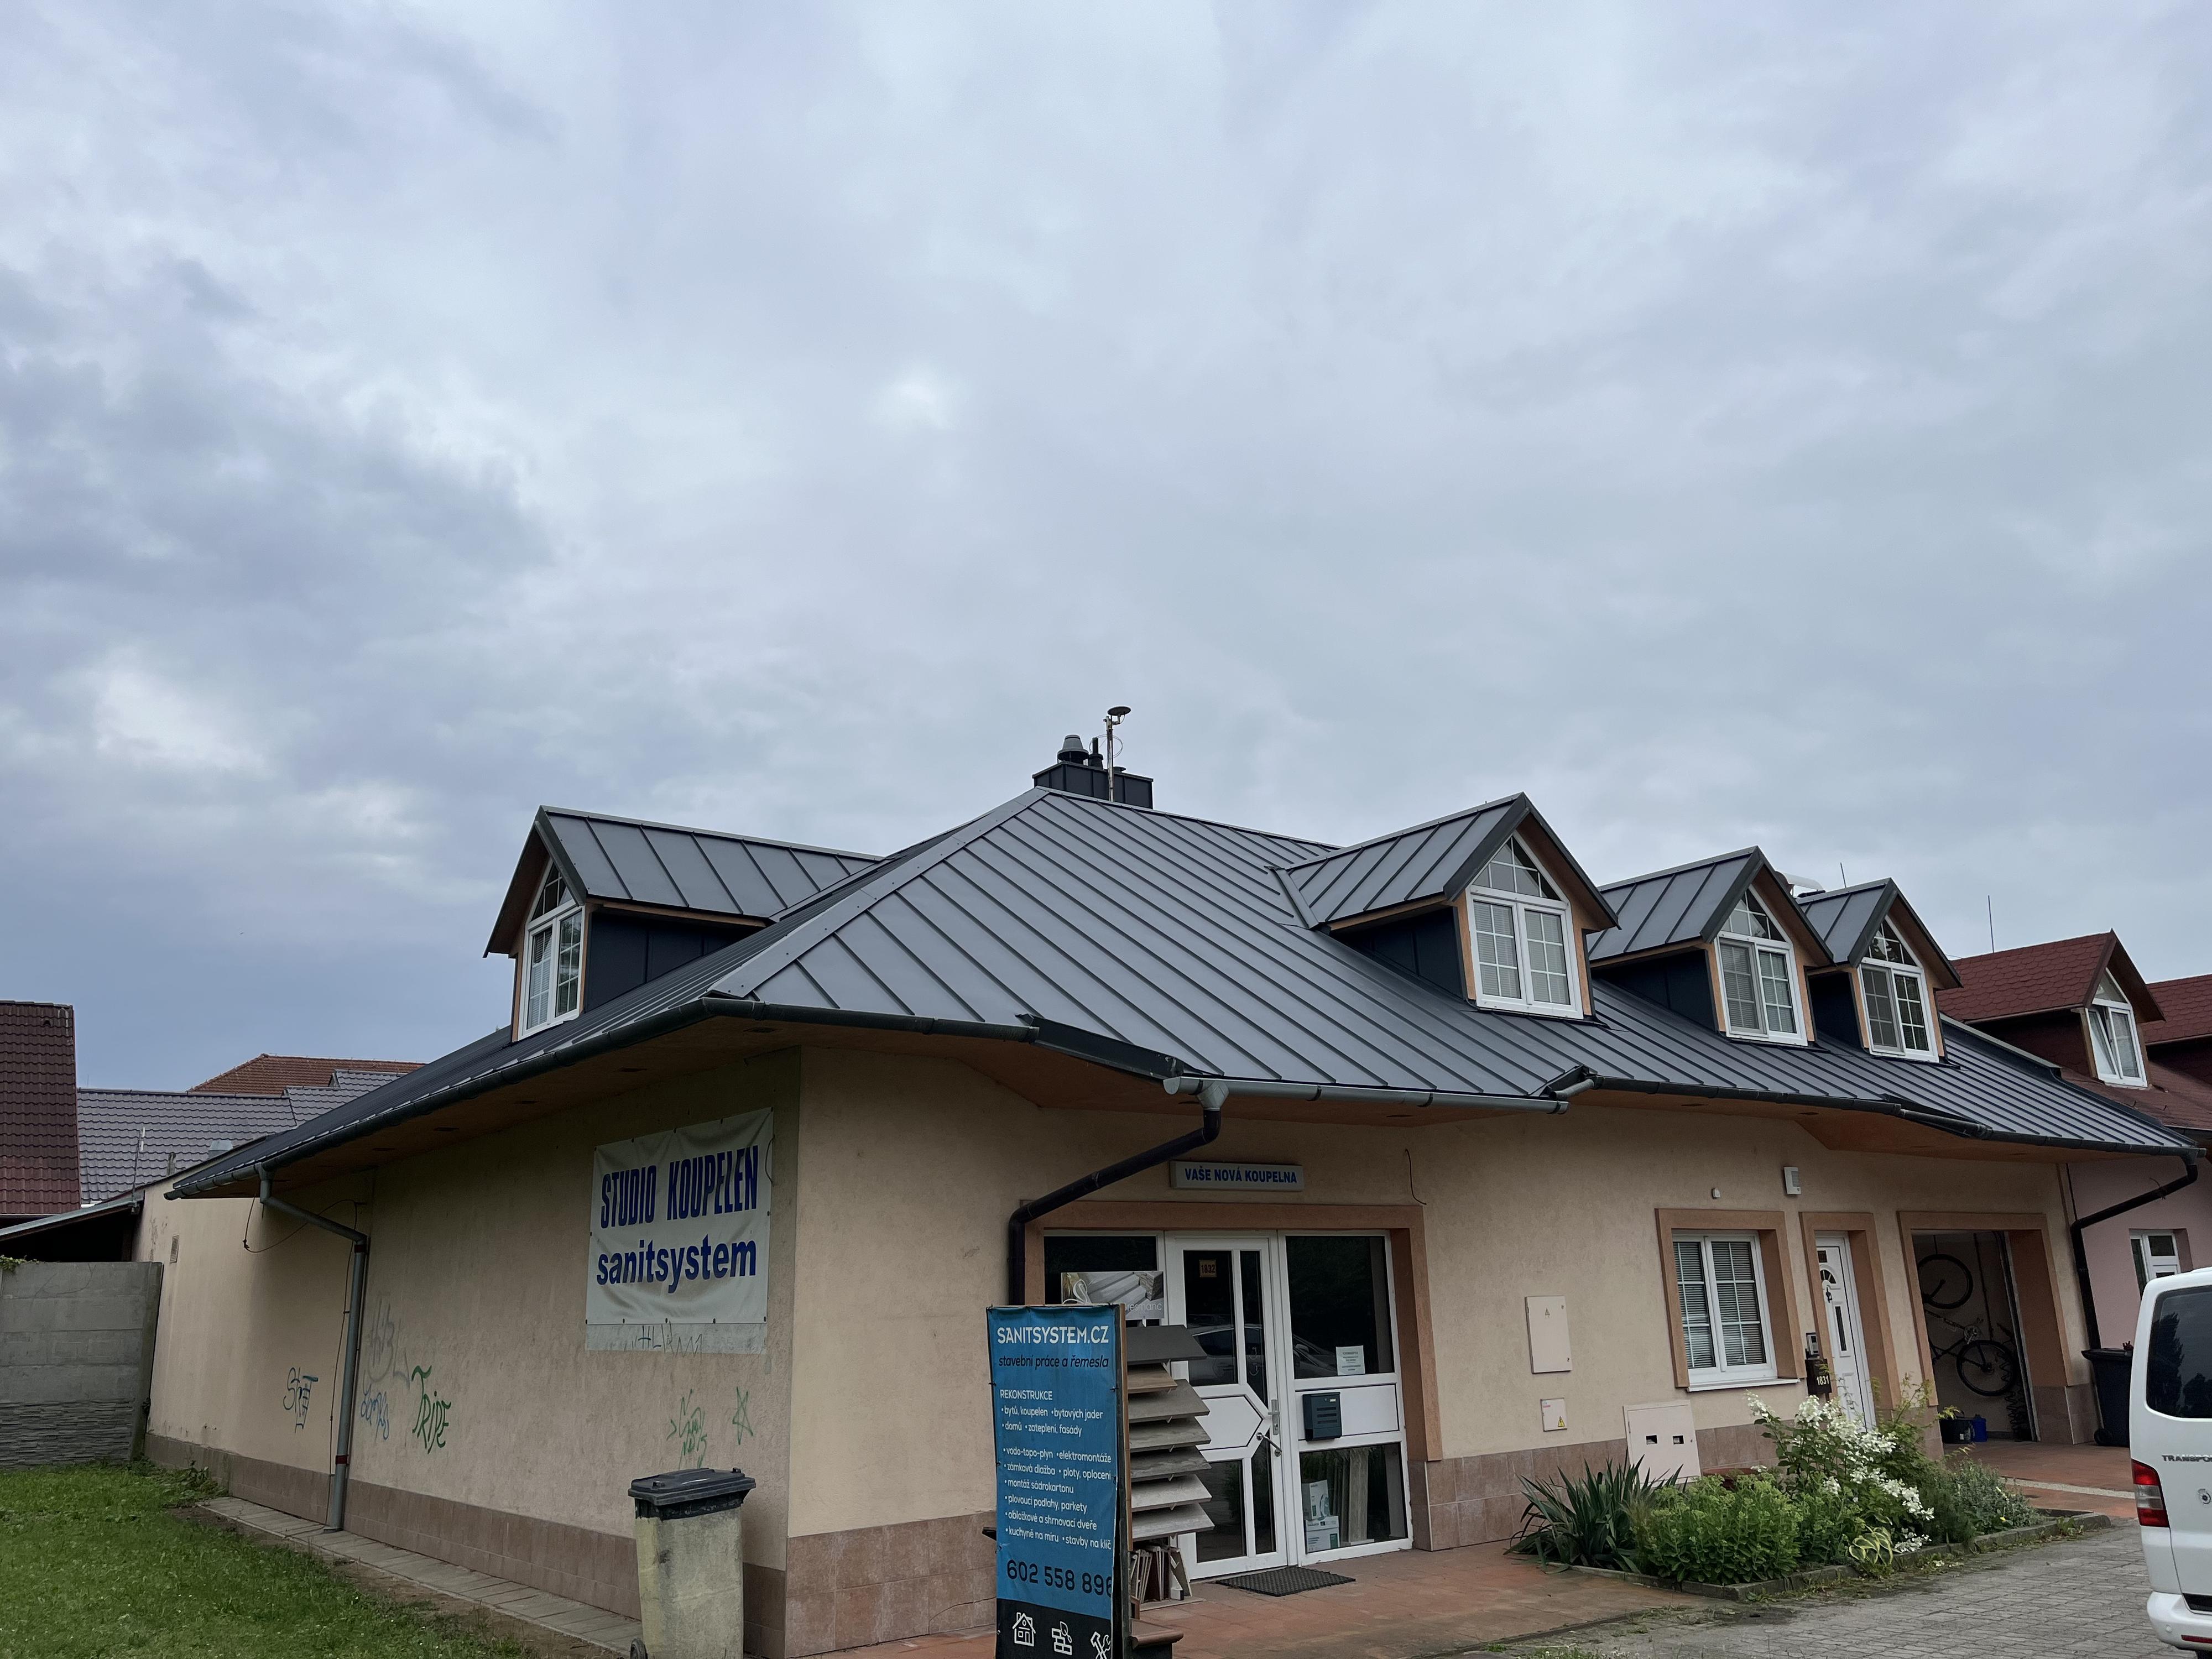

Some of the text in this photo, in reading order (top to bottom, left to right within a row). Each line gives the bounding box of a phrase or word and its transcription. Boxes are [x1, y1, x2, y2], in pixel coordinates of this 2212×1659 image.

[1185, 1165, 1297, 1183] VAŠE NOVÁ KOUPELNA
[601, 1145, 758, 1228] STUDIO KOUPELEN
[597, 1234, 756, 1293] sanitsystem
[1201, 1264, 1215, 1274] 1832
[997, 1326, 1109, 1344] SANITSYSTEM.CZ
[999, 1355, 1109, 1370] stavební práce a řemesla
[1817, 1375, 1829, 1385] 1831
[1000, 1389, 1053, 1401] REKONSTRUKCE
[1020, 1406, 1048, 1418] koupelen
[1053, 1407, 1083, 1420] bytových
[1084, 1408, 1103, 1422] jader
[1005, 1421, 1022, 1431] domů
[1059, 1423, 1082, 1437] fasády
[1006, 1447, 1112, 1463] vodo-topo-plyn elektromontáže
[1007, 1462, 1032, 1473] zámková
[1034, 1464, 1055, 1475] dlažba
[1082, 1469, 1111, 1481] oplocení
[1008, 1479, 1074, 1494] montáž sádrokartonu
[1008, 1494, 1032, 1505] plovoucí
[1061, 1501, 1087, 1515] parkety
[1008, 1510, 1037, 1522] obložkové
[1045, 1515, 1076, 1527] shrnovací
[1077, 1519, 1097, 1531] dveře
[1009, 1526, 1111, 1550] kuchyně na míru stavby na klíč
[1007, 1559, 1039, 1584] 602
[1045, 1566, 1075, 1591] 558
